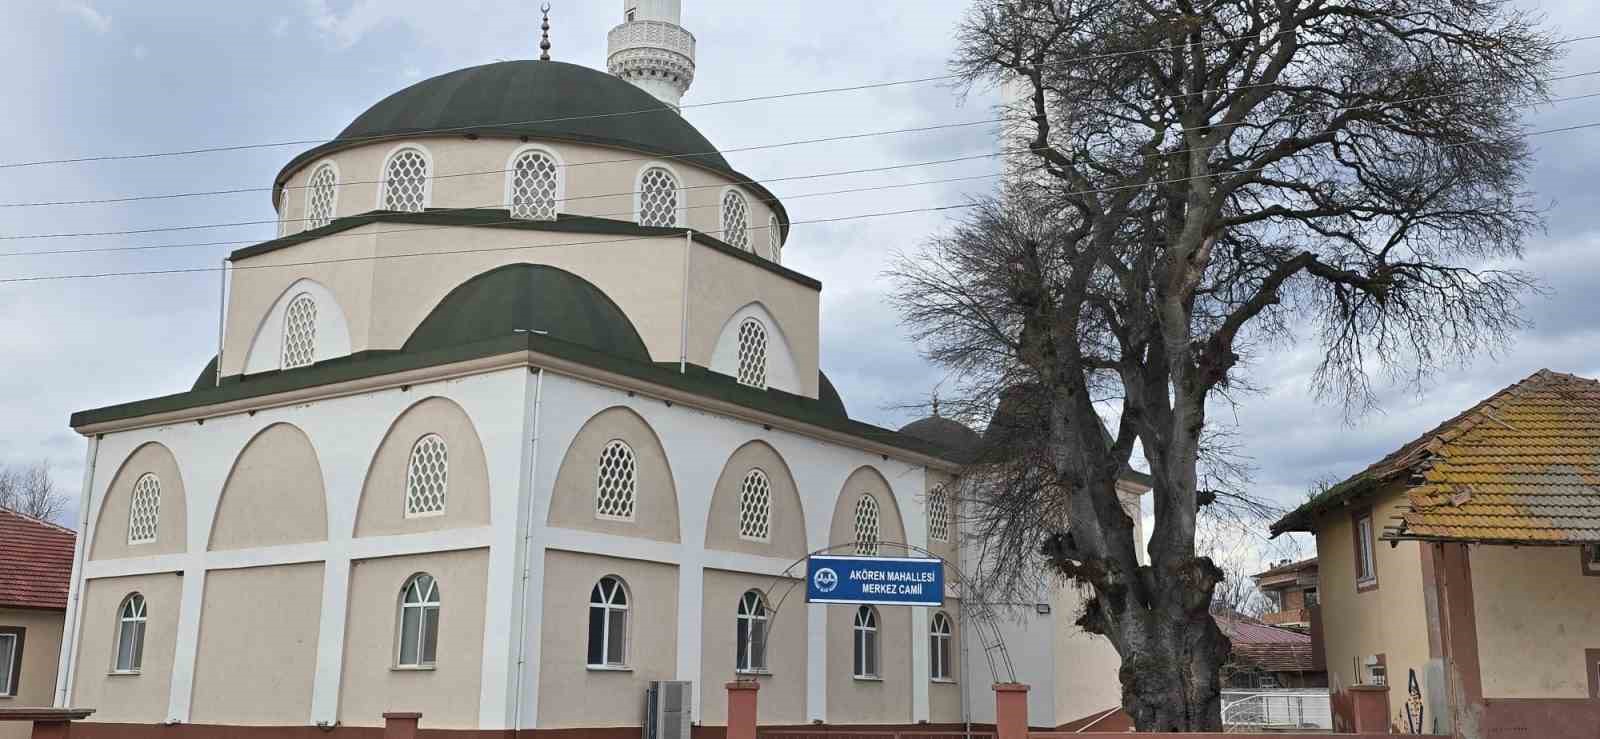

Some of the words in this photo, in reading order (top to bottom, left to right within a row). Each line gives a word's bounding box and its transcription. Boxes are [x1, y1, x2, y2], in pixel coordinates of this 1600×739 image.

[849, 569, 885, 581] AKÖREN
[887, 570, 936, 582] MAHALLESİ
[862, 583, 897, 595] MERKEZ
[898, 583, 923, 595] CAMİİ
